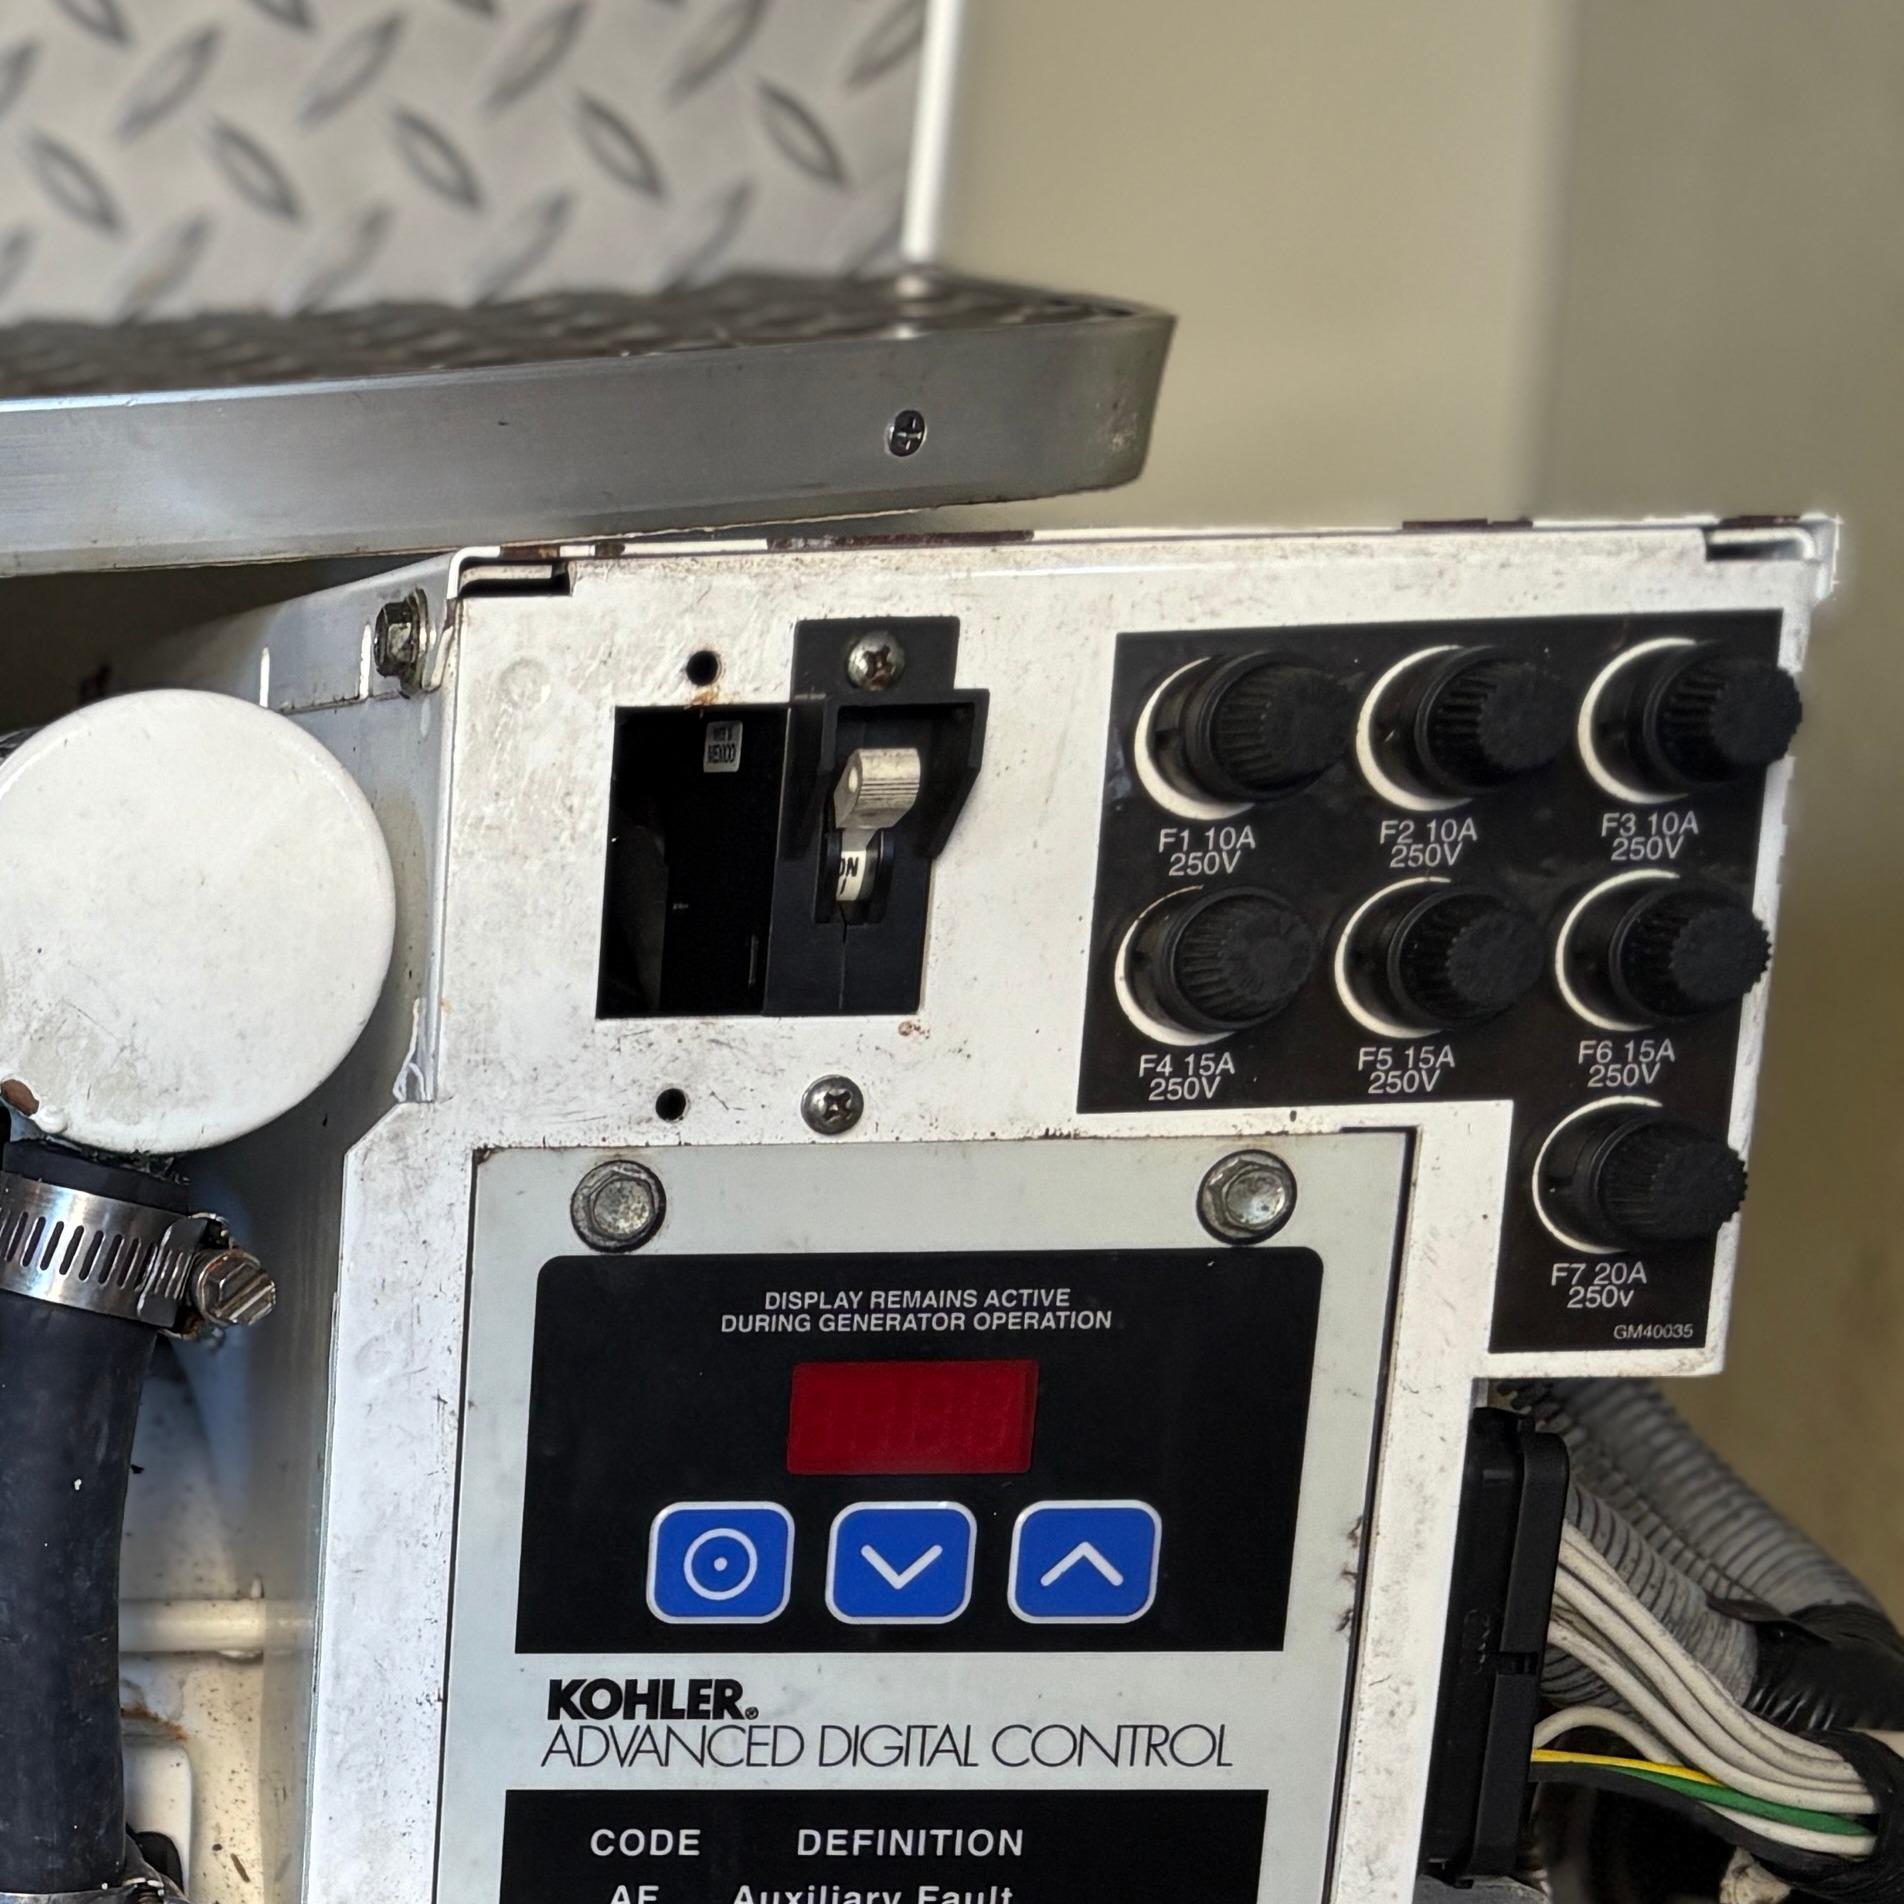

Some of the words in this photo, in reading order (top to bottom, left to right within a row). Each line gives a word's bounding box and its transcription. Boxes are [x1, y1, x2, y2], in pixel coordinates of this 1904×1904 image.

[1380, 820, 1418, 845] F2
[1427, 819, 1478, 843] 10A
[1600, 813, 1640, 838] F3
[1648, 812, 1700, 836] 10A
[1158, 828, 1198, 852] F1
[1206, 826, 1256, 851] 10A
[1610, 836, 1684, 861] 250V
[1168, 851, 1241, 876] 250V
[1390, 842, 1463, 868] 250V
[1138, 1054, 1177, 1078] F4
[1186, 1052, 1236, 1076] 15A
[1358, 1048, 1397, 1071] F5
[1406, 1046, 1455, 1070] 15A
[1578, 1041, 1618, 1065] F6
[1626, 1040, 1676, 1064] 15A
[1148, 1076, 1221, 1100] 250V
[1368, 1070, 1441, 1094] 250V
[1588, 1064, 1661, 1088] 250V
[1550, 1264, 1588, 1286] F7
[1596, 1262, 1647, 1285] 20A
[764, 1290, 863, 1311] DISPLAY
[870, 1289, 977, 1309] REMAINS
[985, 1287, 1073, 1308] ACTIVE
[720, 1312, 812, 1334] DURING
[818, 1311, 966, 1333] GENERATOR
[973, 1308, 1113, 1331] OPERATION
[1614, 1325, 1694, 1340] GM40035
[541, 1723, 804, 1769] ADVANCED
[818, 1723, 979, 1768] DIGITAL
[991, 1722, 1234, 1767] CONTROL
[591, 1828, 702, 1857] CODE
[797, 1828, 1023, 1857] DEFINITION
